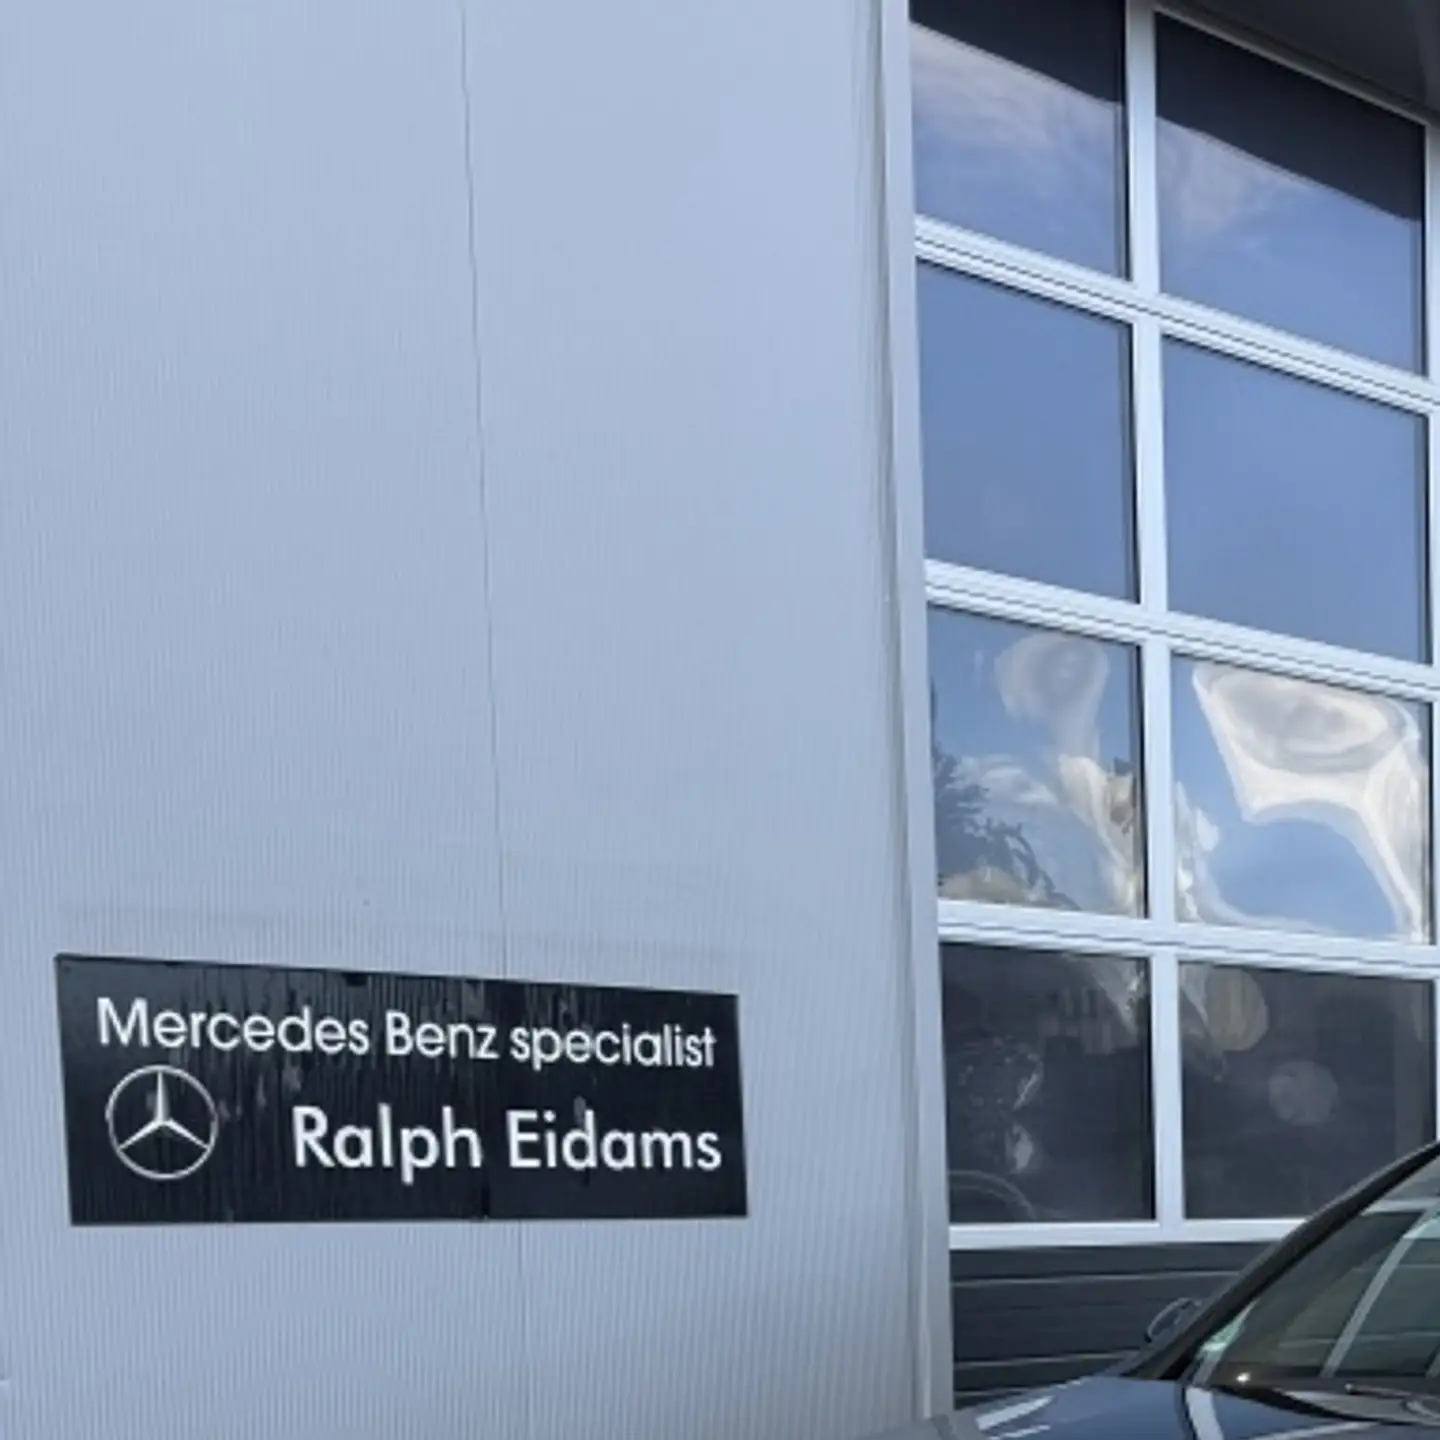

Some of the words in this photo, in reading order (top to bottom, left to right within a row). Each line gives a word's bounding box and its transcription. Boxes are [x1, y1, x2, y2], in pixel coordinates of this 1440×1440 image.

[97, 996, 370, 1055] Mercedes
[385, 1009, 499, 1059] Benz
[510, 1023, 715, 1071] specialist
[292, 1103, 482, 1184] Ralph
[507, 1109, 722, 1170] Eidams
